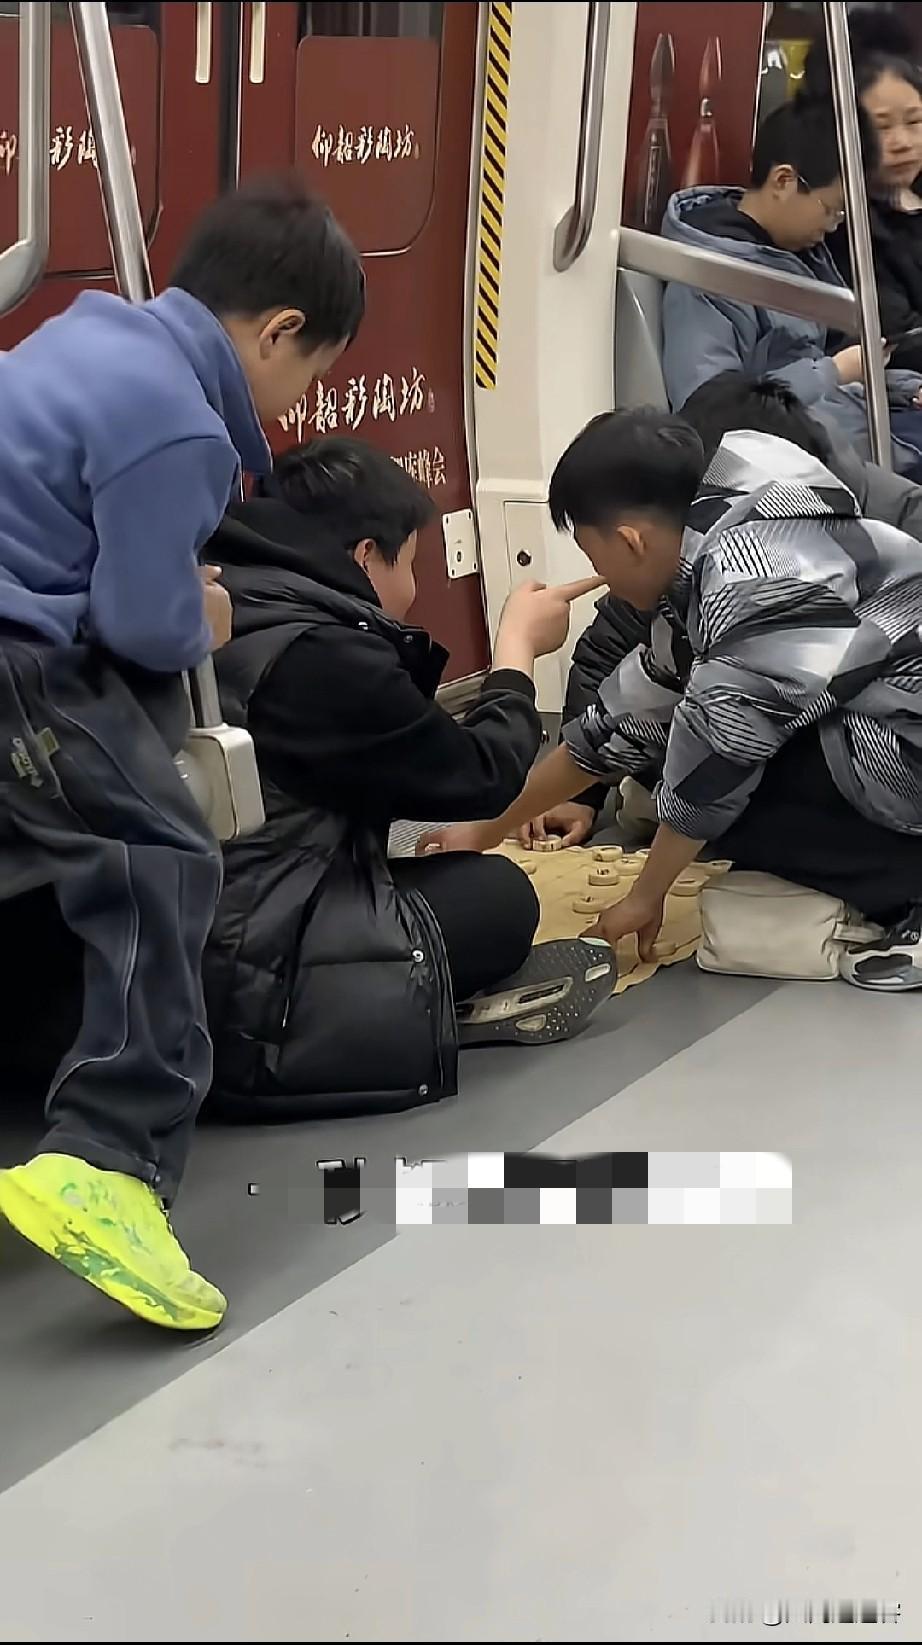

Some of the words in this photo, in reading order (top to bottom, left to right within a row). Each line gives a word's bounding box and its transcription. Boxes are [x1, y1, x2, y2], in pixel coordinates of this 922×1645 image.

[311, 124, 415, 167] 仰韶彩陶坊
